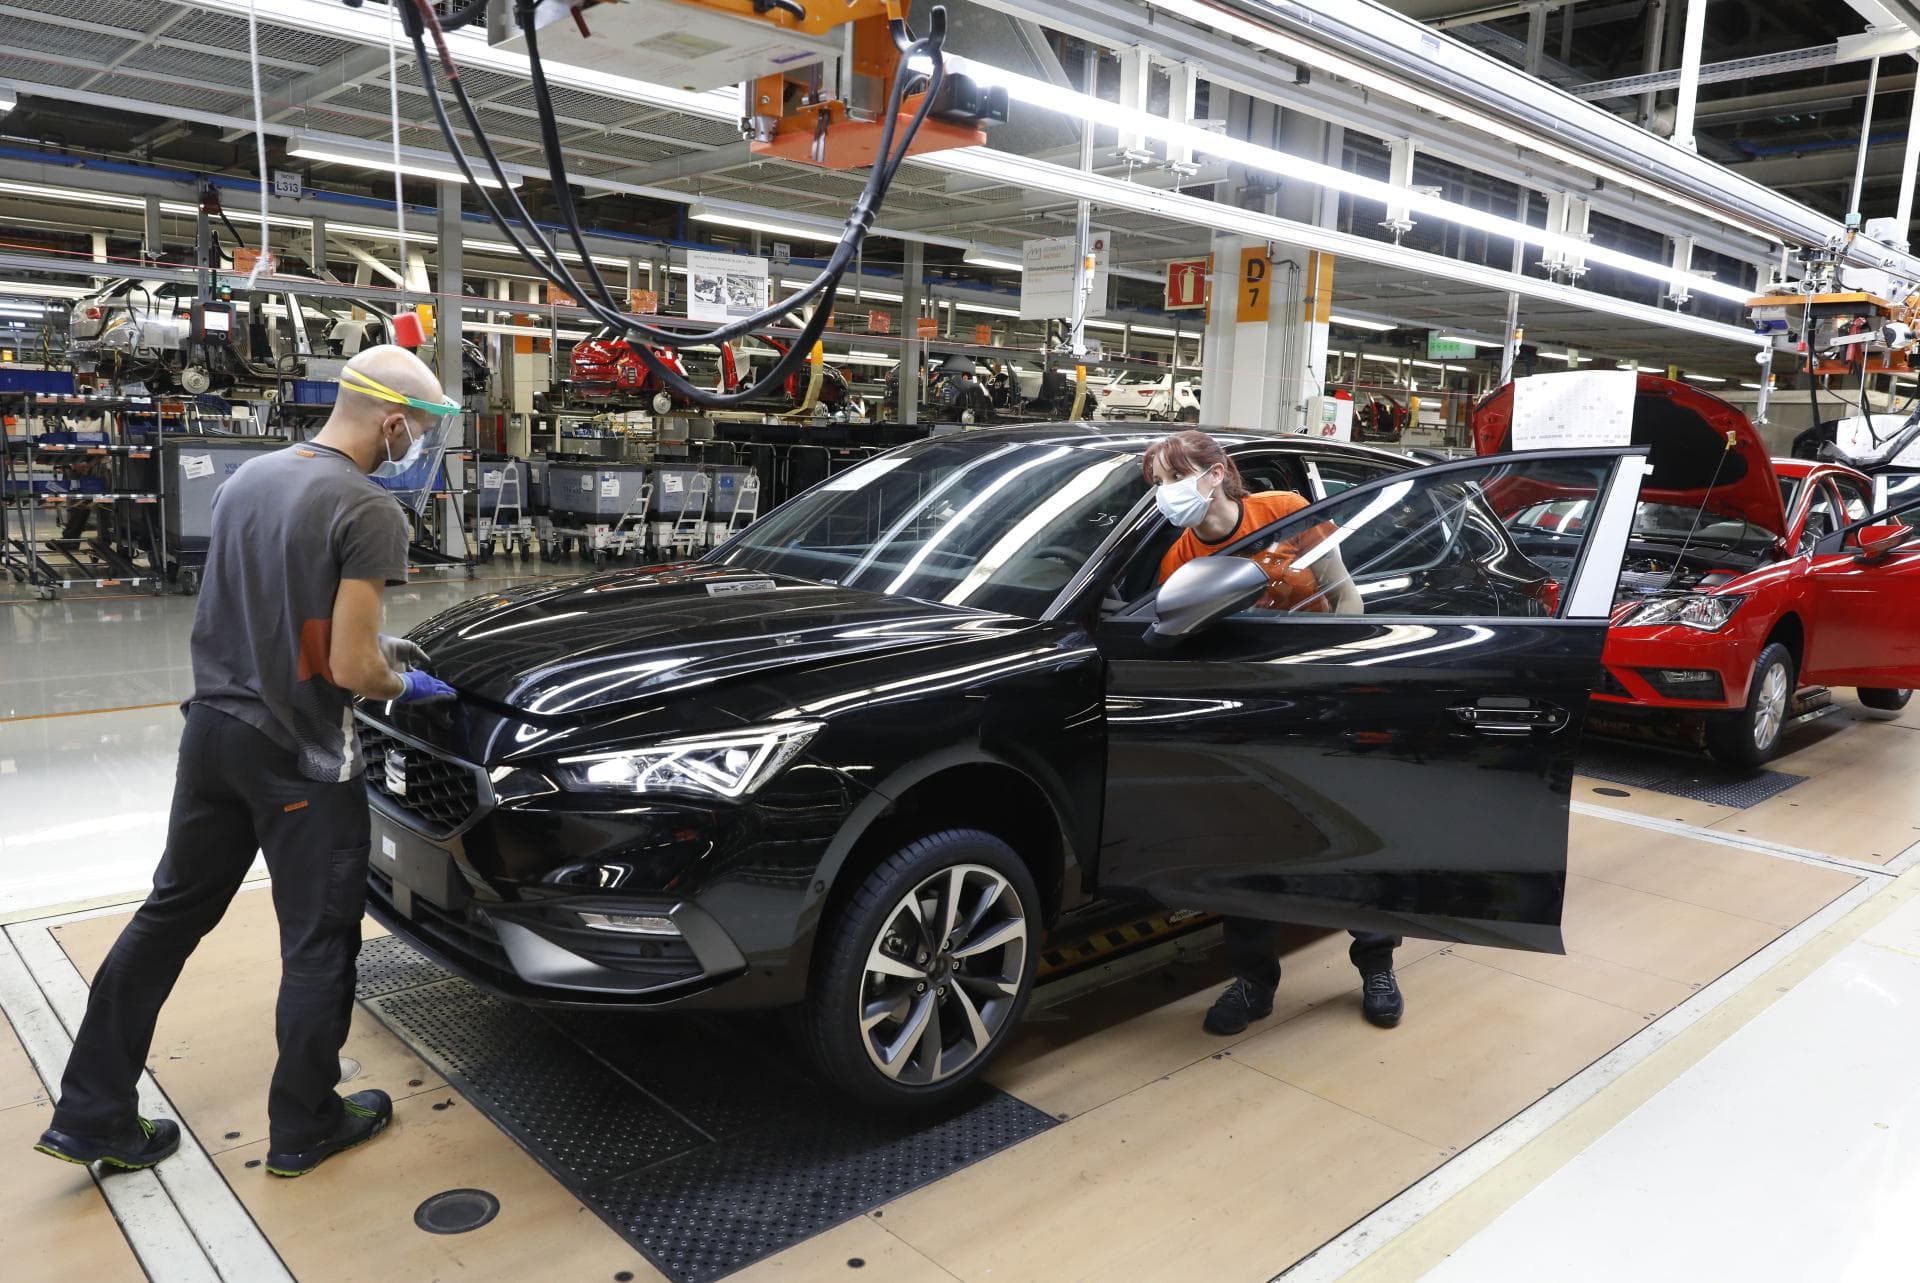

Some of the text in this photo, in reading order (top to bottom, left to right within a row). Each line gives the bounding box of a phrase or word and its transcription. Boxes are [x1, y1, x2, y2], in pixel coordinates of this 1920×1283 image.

[276, 181, 299, 193] L313
[1247, 258, 1265, 283] D
[1249, 288, 1259, 307] 7
